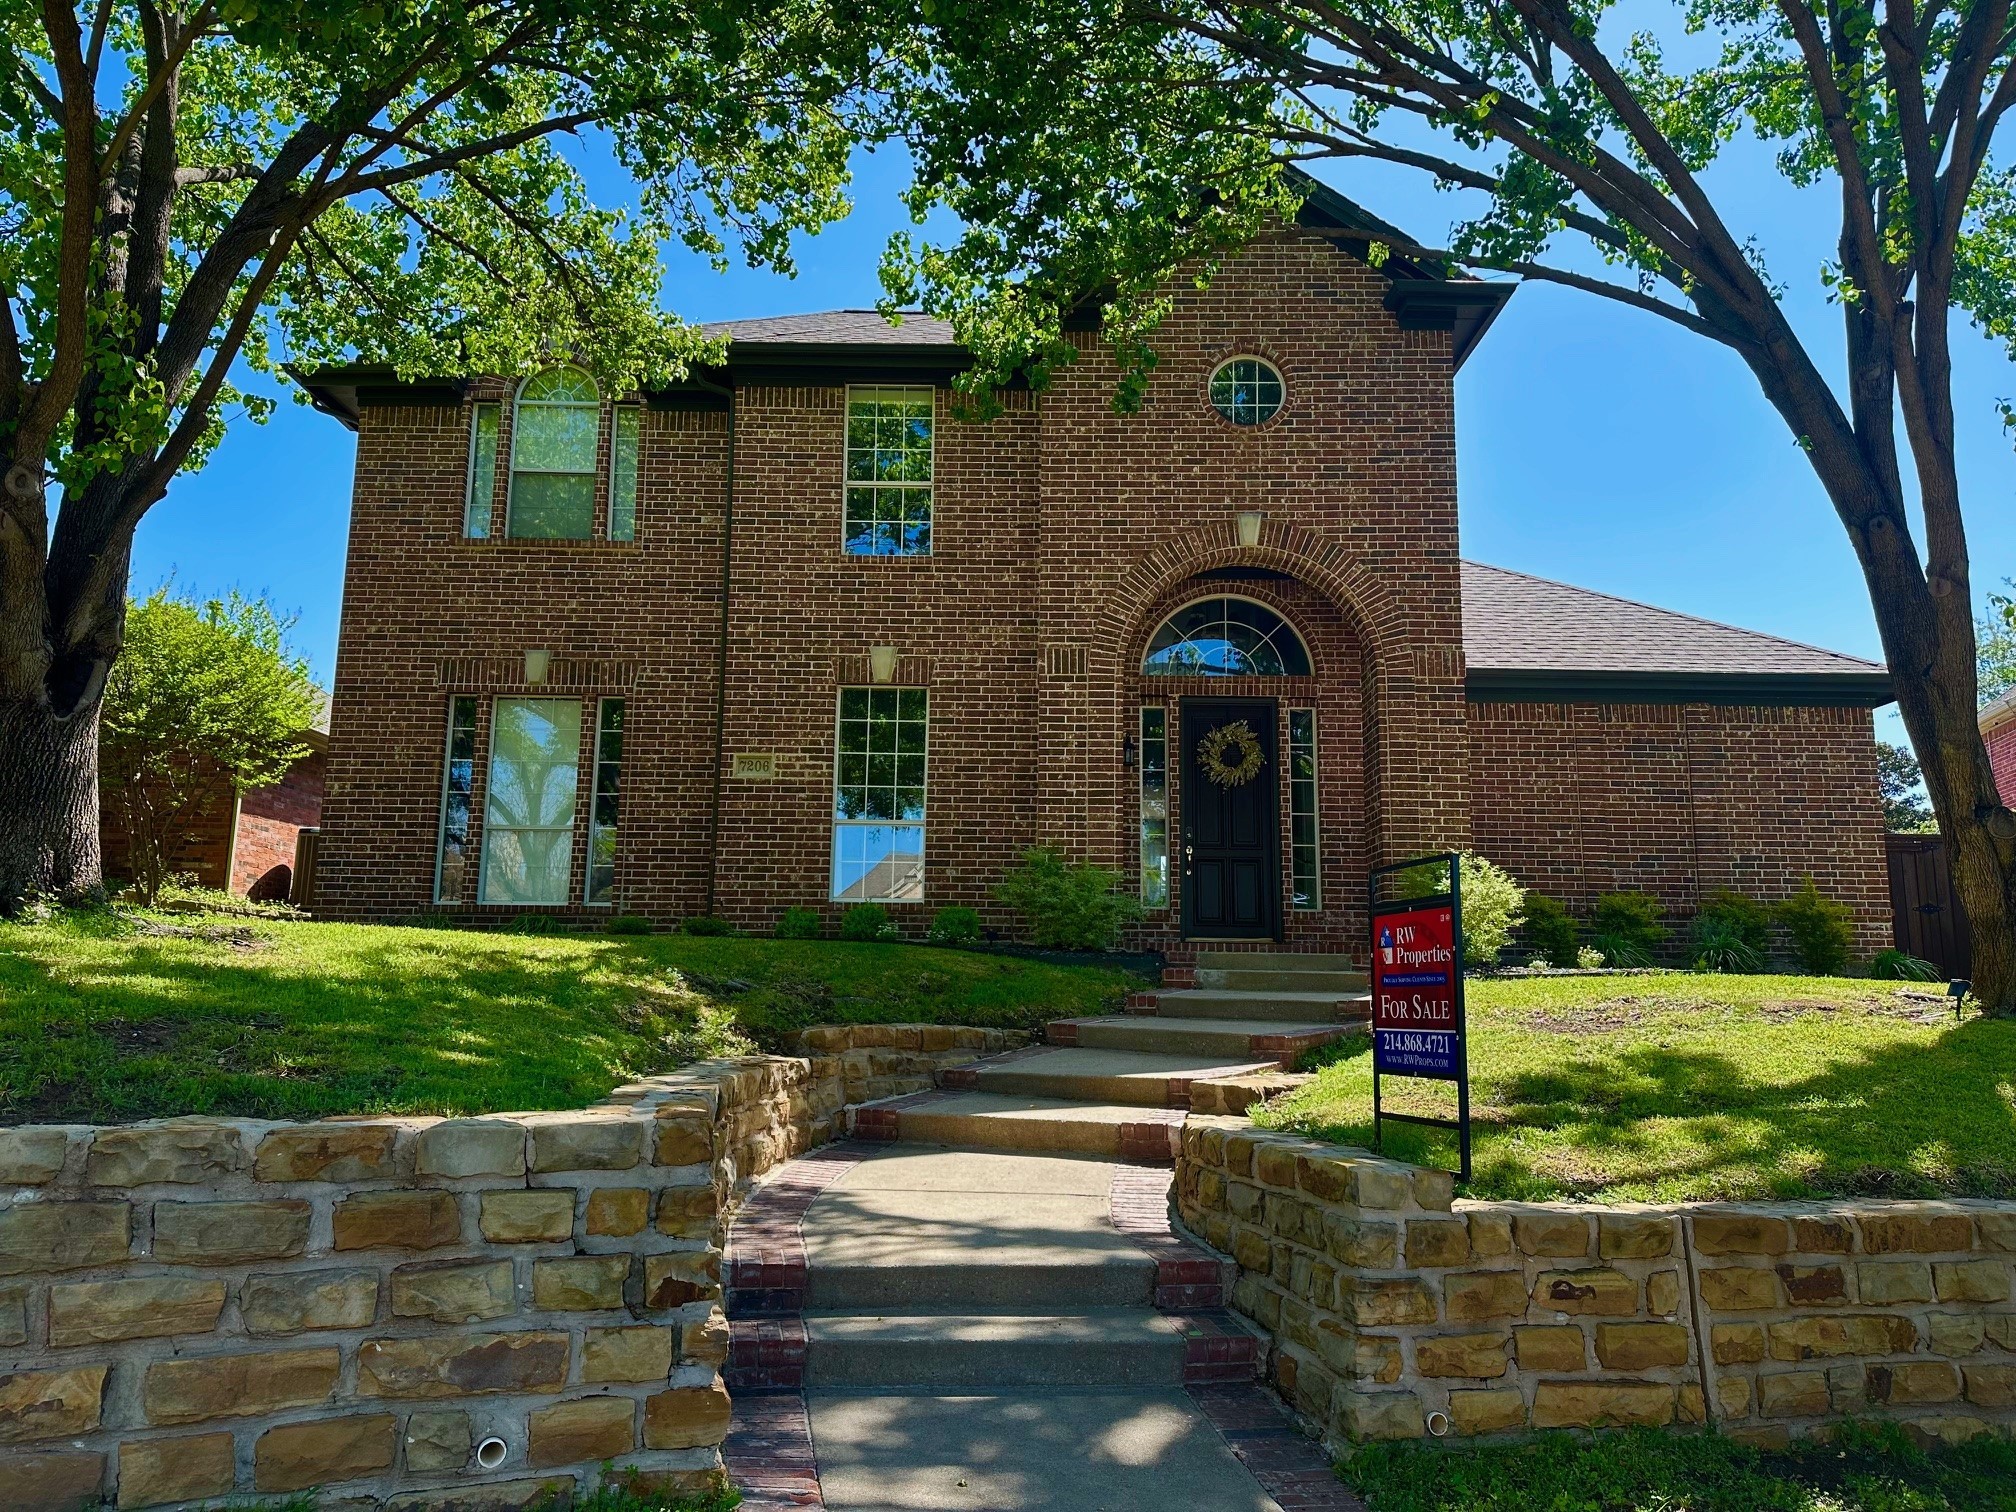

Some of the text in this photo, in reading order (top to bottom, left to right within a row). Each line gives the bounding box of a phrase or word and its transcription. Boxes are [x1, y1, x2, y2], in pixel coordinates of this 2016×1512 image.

[739, 760, 770, 772] 7206
[1396, 926, 1416, 944] RW
[1396, 944, 1451, 967] Properties
[1381, 995, 1409, 1019] FOR
[1383, 1033, 1450, 1054] 214.868.4721
